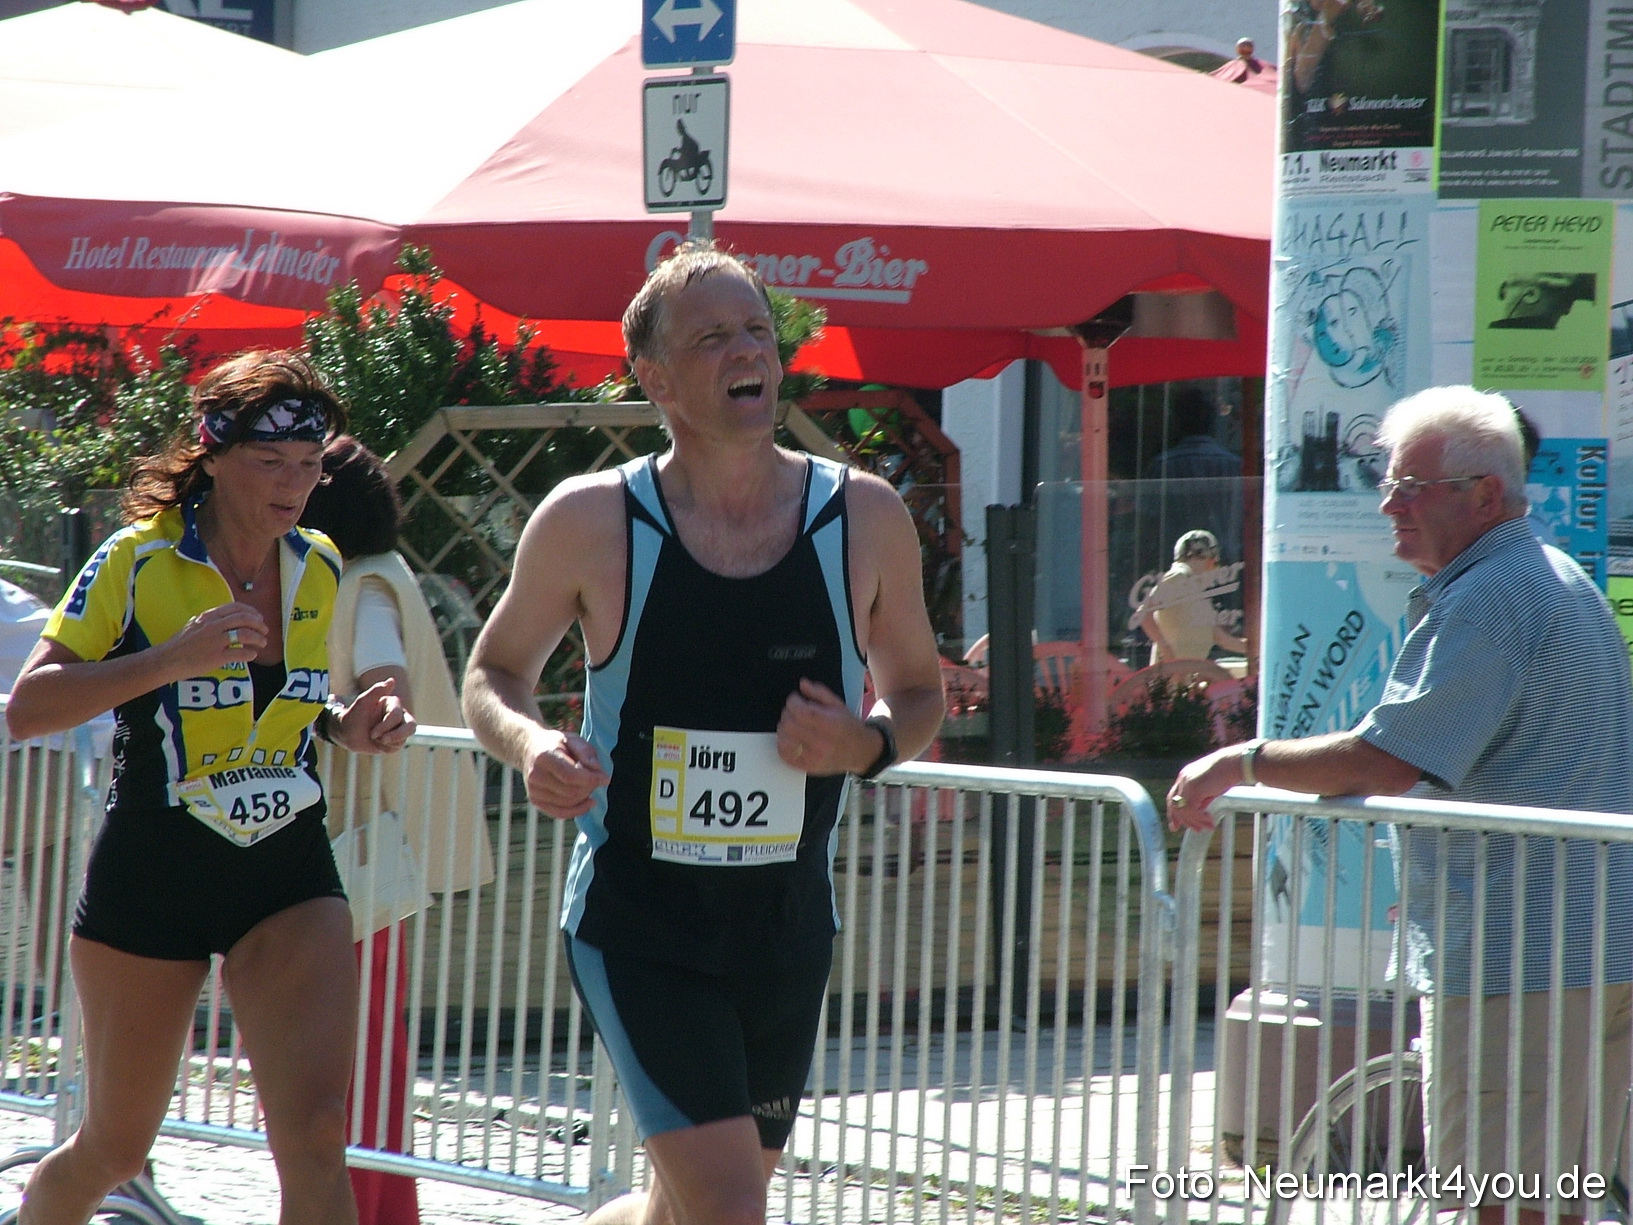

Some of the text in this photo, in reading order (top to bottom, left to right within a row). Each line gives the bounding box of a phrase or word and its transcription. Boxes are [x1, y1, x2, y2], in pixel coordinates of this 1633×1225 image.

[671, 92, 702, 115] nur
[1318, 150, 1397, 173] Neumarkt
[1489, 214, 1603, 233] PETER HEYD
[64, 236, 130, 270] Hotel
[1576, 444, 1607, 533] Kultur
[1274, 623, 1312, 740] AVARIAN
[1289, 692, 1323, 740] PEN
[1312, 608, 1366, 692] WORD
[688, 744, 736, 773] Jörg
[208, 767, 297, 790] Marianne
[659, 778, 675, 798] D
[229, 790, 292, 825] 458
[689, 789, 770, 828] 492
